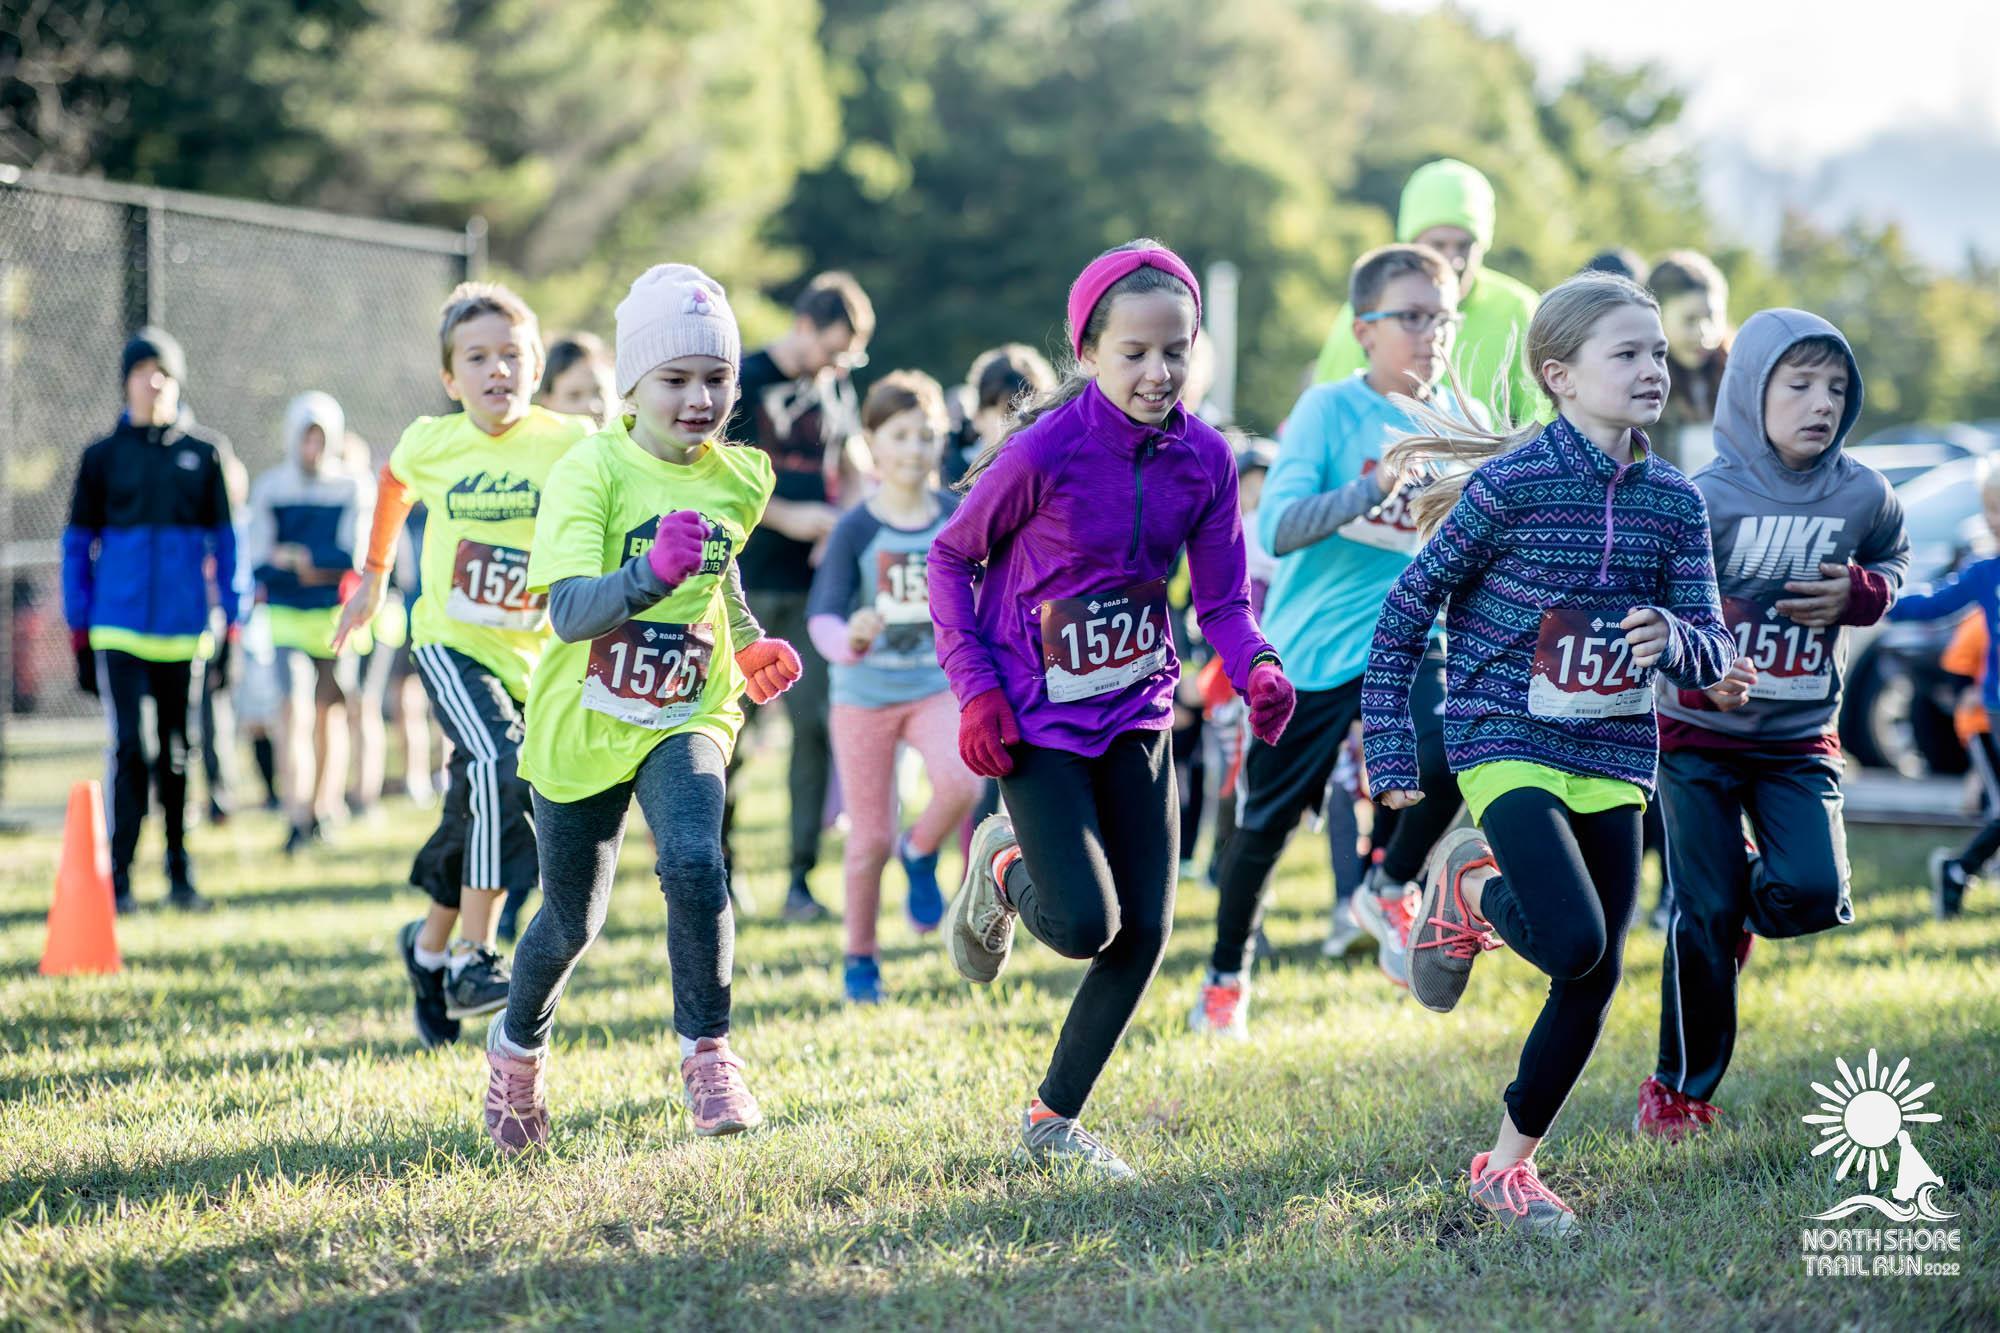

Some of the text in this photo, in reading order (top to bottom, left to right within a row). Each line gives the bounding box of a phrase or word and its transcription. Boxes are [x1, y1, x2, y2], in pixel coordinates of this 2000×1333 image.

[1723, 515, 1846, 580] NIKE
[1103, 599, 1121, 608] ROAD
[1061, 605, 1155, 670] 1526
[1734, 621, 1825, 672] 1515
[610, 641, 701, 699] 1525
